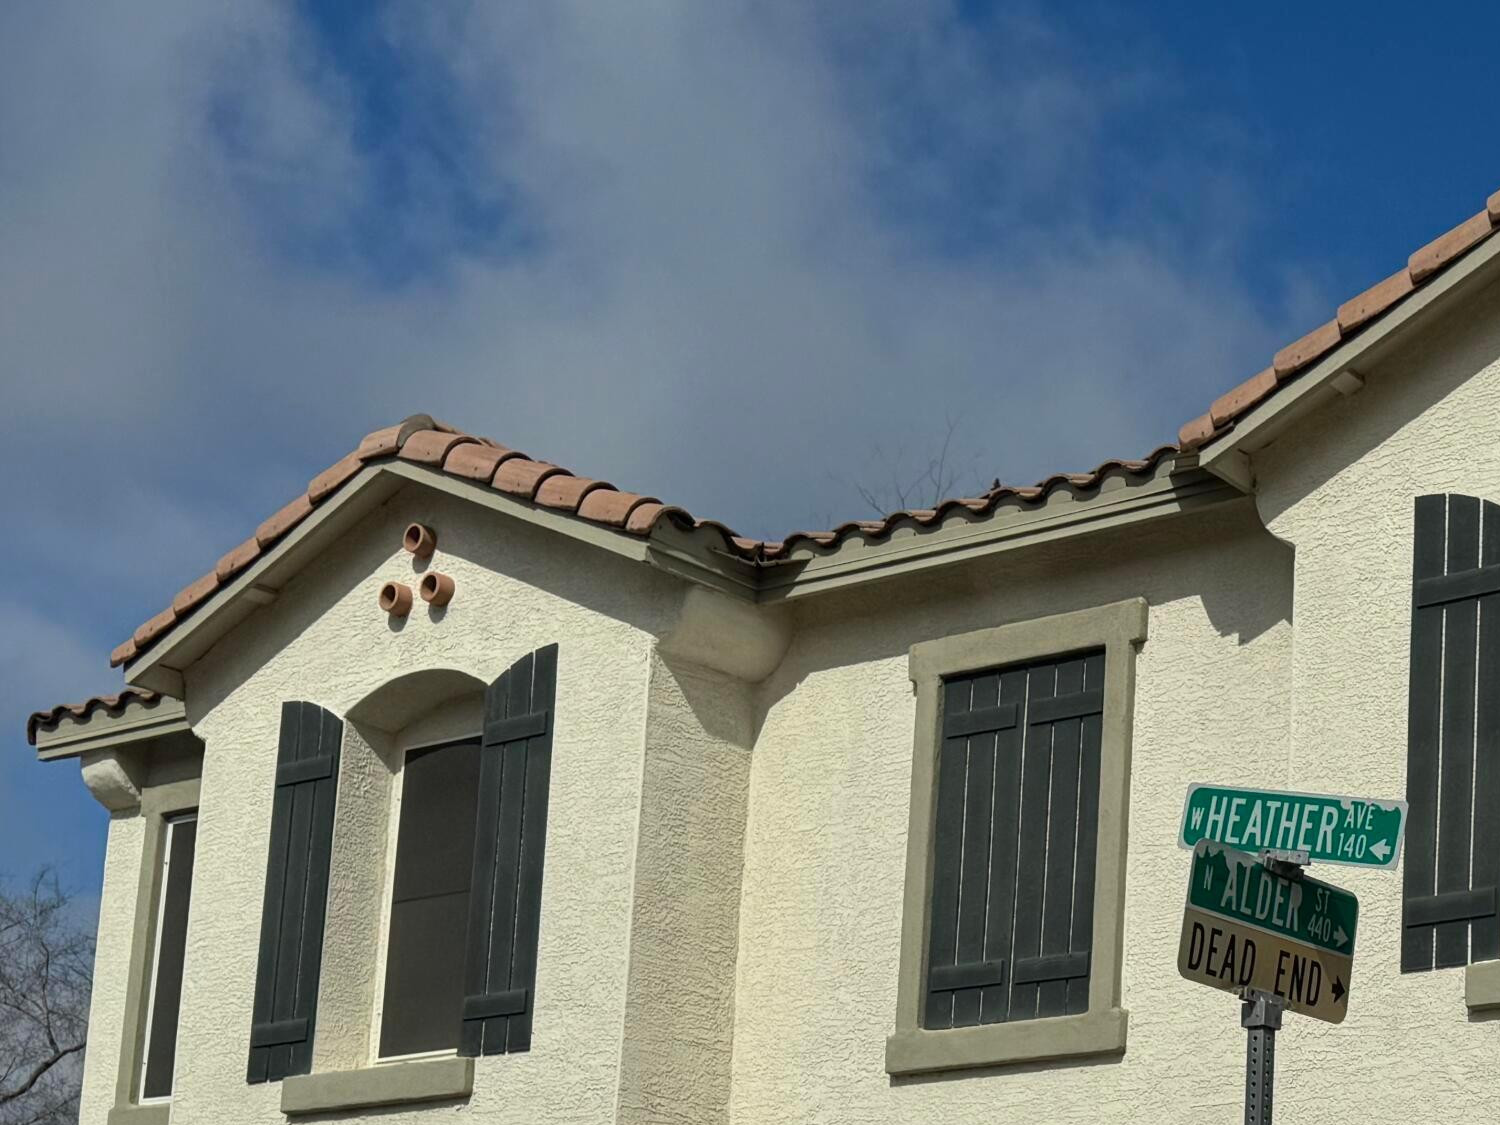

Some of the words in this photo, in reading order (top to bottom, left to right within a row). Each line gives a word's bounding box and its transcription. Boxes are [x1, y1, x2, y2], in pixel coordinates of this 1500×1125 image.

[1191, 807, 1205, 830] W
[1205, 796, 1339, 854] HEATHER
[1344, 804, 1376, 830] AVE
[1338, 833, 1367, 858] 140
[1204, 864, 1213, 891] N
[1220, 860, 1303, 932] ALDER
[1315, 887, 1331, 914] ST
[1307, 914, 1332, 942] 440
[1188, 922, 1256, 986] DEAD
[1274, 950, 1322, 1006] END
